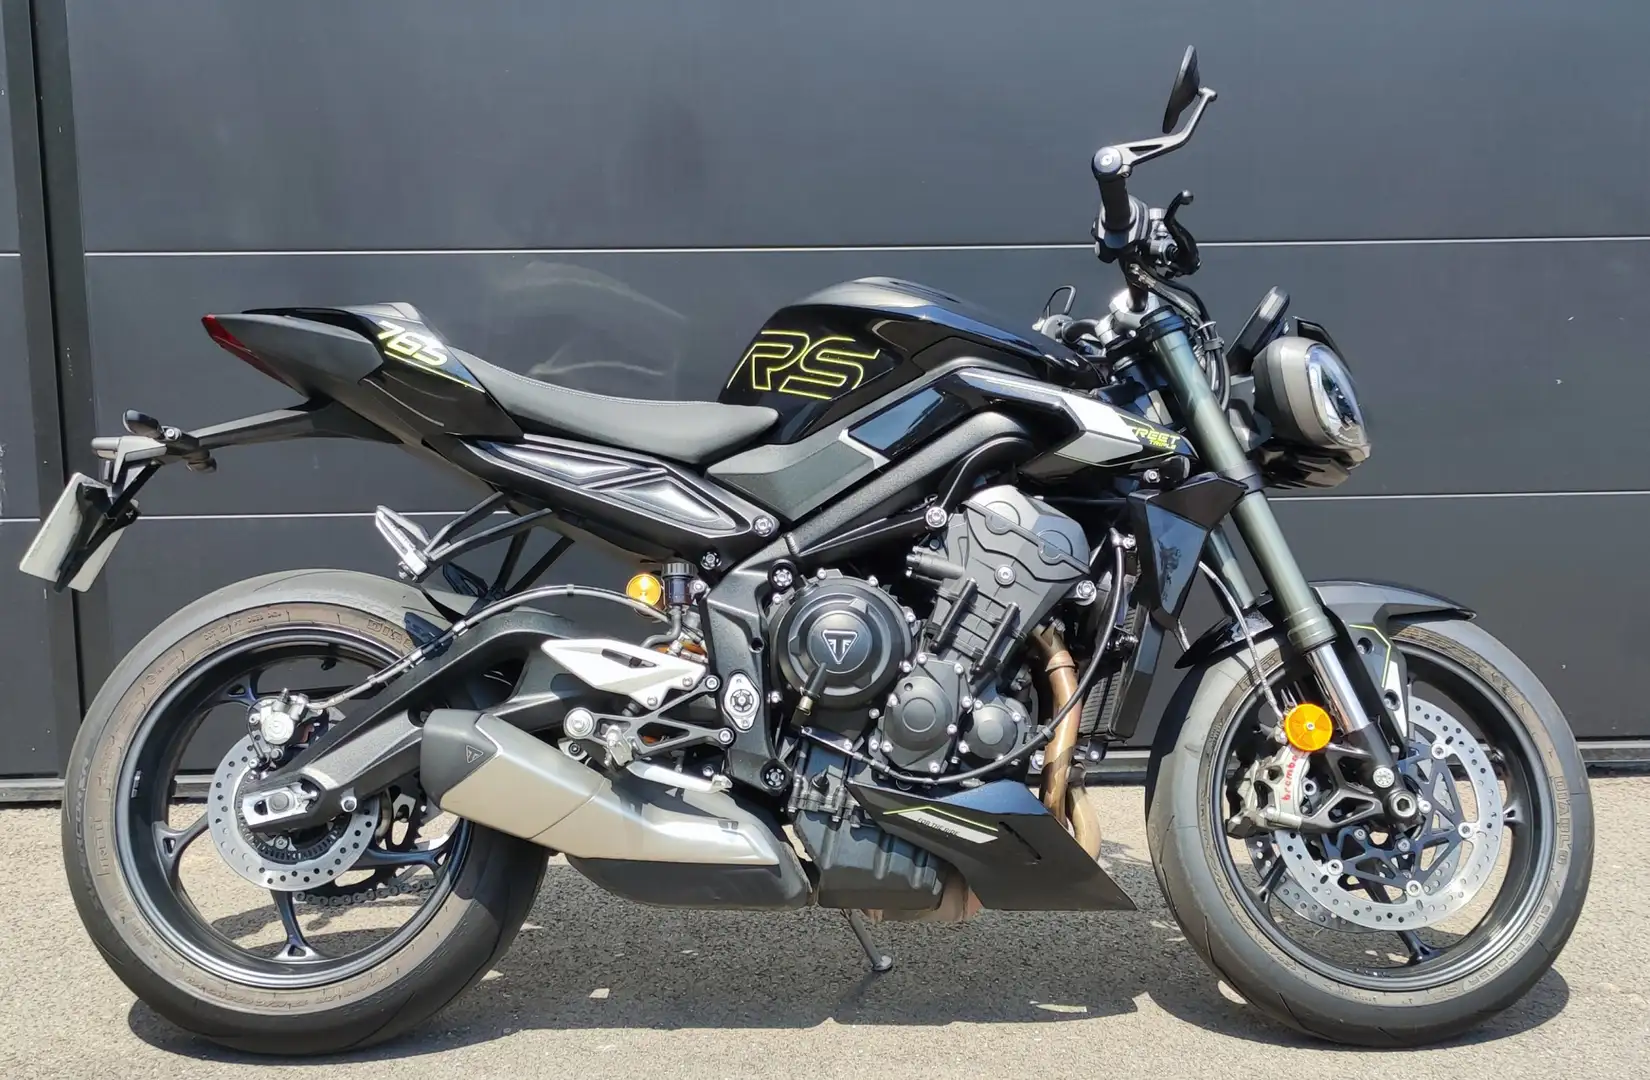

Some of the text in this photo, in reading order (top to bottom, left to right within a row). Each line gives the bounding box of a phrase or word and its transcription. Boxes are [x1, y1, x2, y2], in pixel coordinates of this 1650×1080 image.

[377, 319, 448, 366] 765
[726, 331, 880, 400] RS
[1282, 755, 1298, 801] brembo
[1468, 904, 1552, 987] SUPERCORSA
